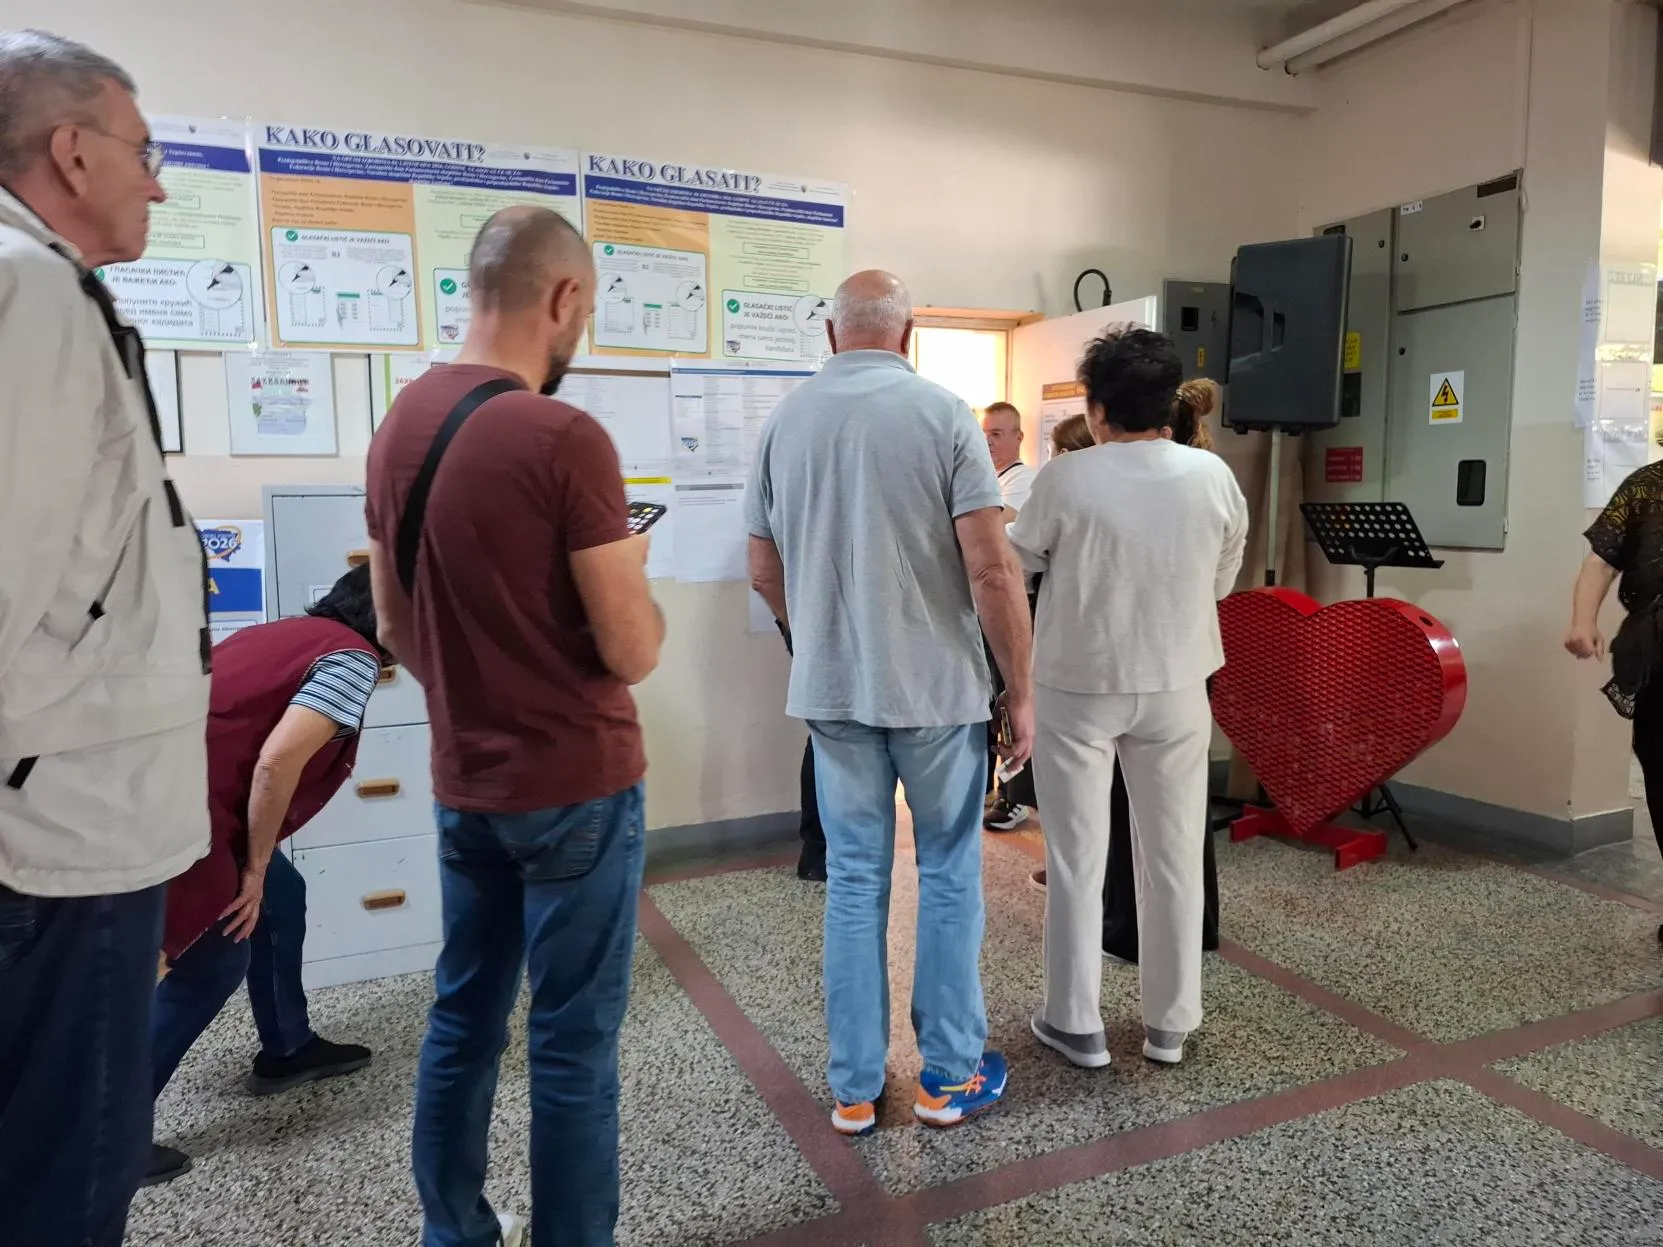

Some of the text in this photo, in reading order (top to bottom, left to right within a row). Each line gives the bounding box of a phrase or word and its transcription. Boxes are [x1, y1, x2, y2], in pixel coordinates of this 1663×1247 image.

[265, 125, 339, 150] KAKO
[344, 131, 486, 163] GLASOVATI?
[588, 154, 656, 182] KAKO
[660, 163, 762, 193] GLASATI?
